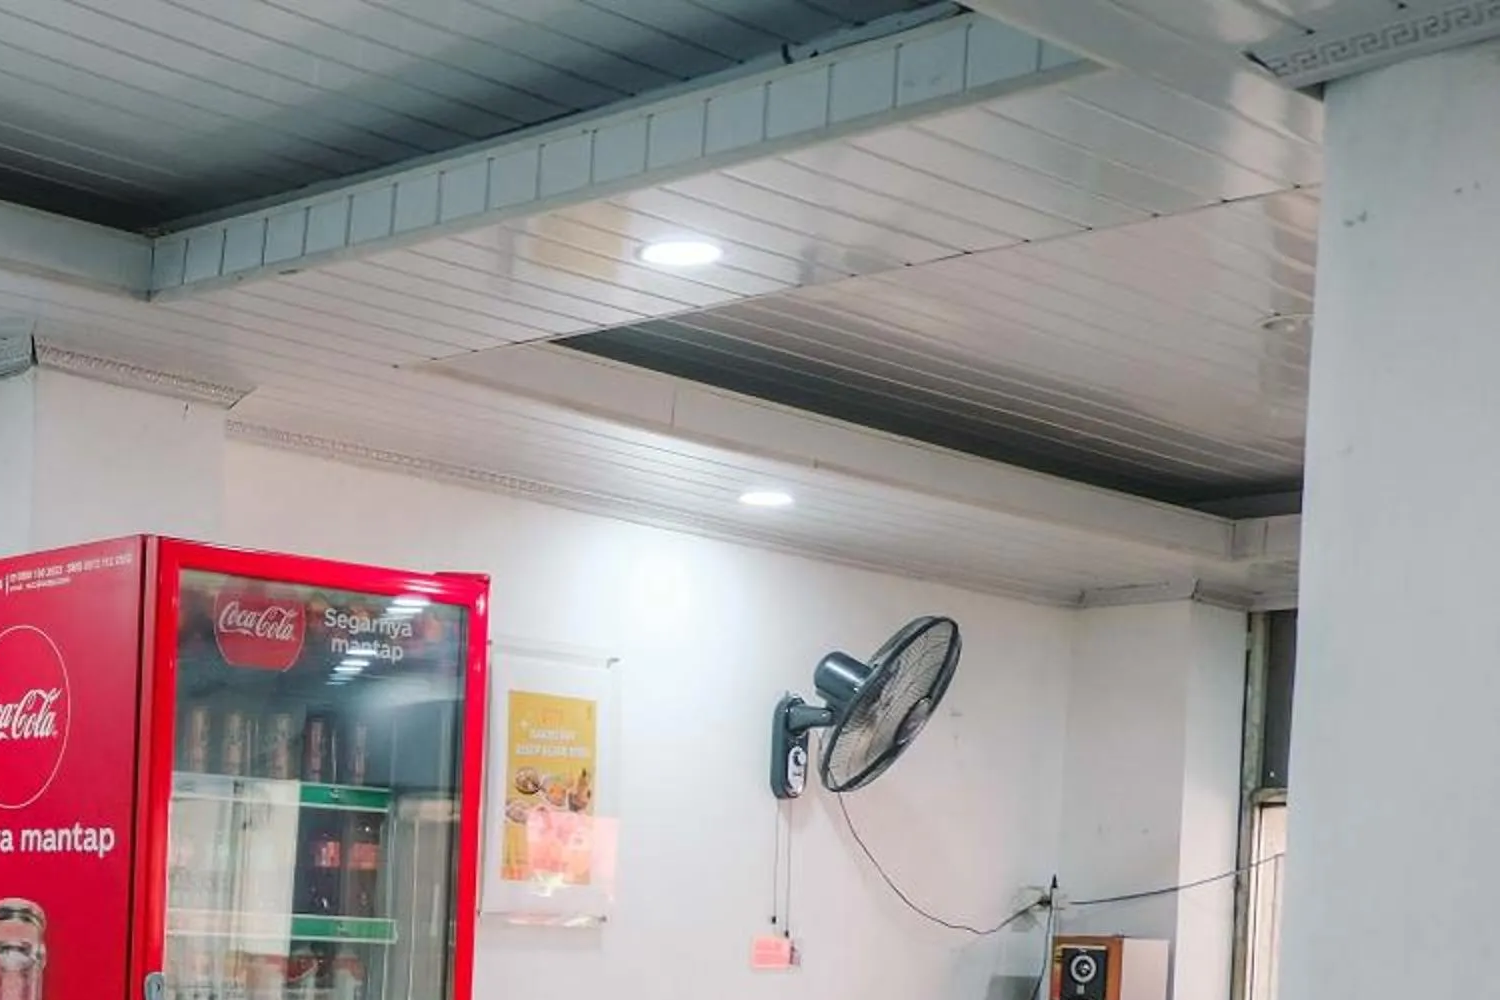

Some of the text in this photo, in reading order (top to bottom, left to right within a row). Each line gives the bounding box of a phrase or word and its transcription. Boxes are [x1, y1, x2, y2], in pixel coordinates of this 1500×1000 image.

[323, 607, 413, 639] Segarnya
[330, 636, 404, 664] mantap
[20, 822, 115, 858] mantap
